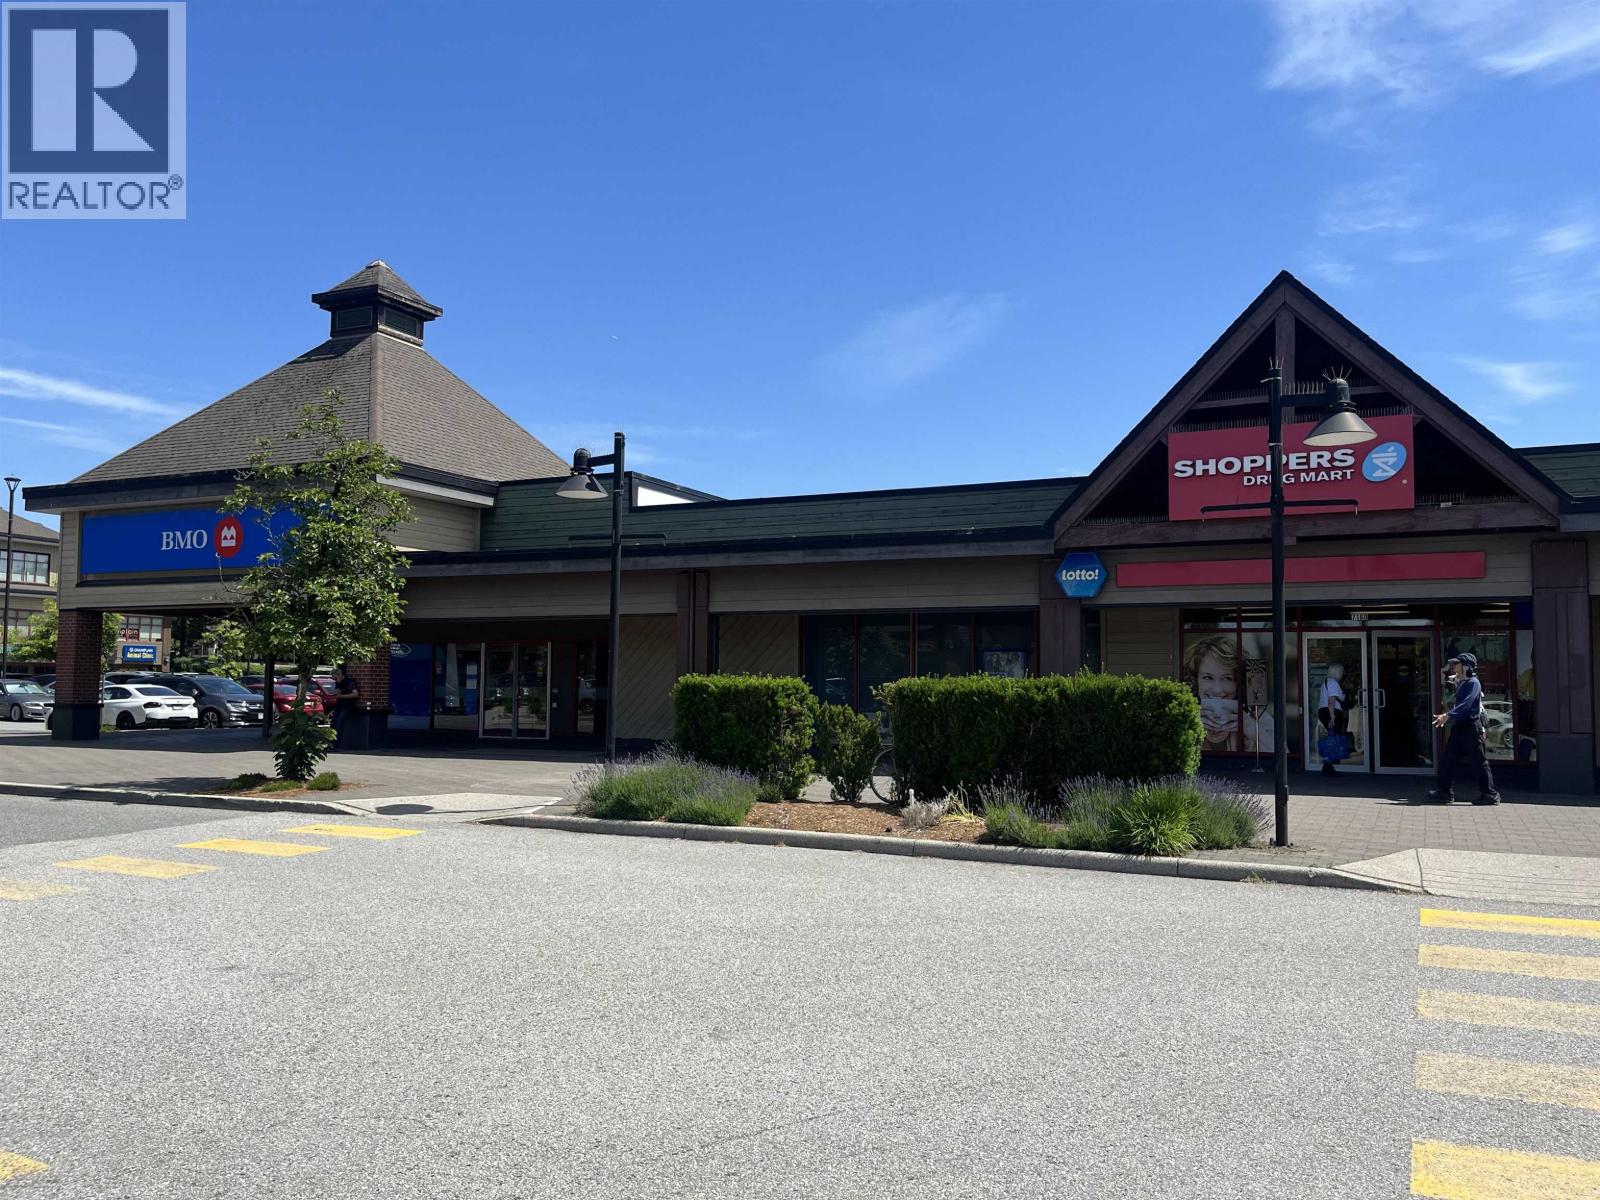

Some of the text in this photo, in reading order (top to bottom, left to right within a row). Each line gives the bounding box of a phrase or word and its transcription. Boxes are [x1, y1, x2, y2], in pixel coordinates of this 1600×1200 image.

[1243, 468, 1356, 486] DRG MART
[160, 529, 208, 551] BMO
[1061, 568, 1099, 581] lotto!
